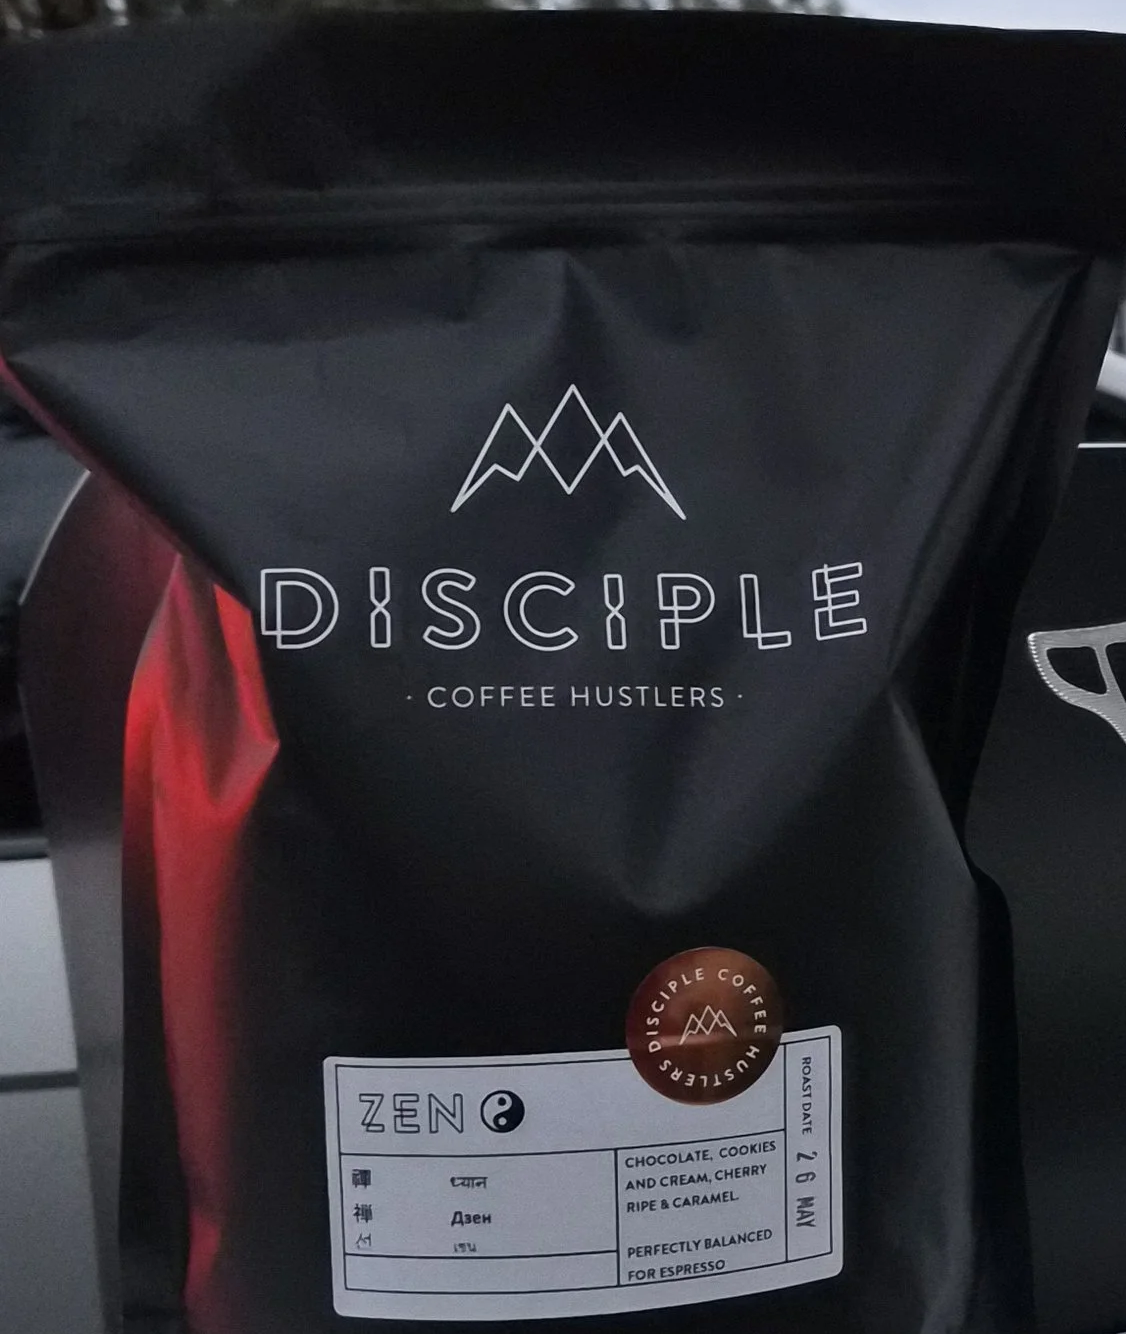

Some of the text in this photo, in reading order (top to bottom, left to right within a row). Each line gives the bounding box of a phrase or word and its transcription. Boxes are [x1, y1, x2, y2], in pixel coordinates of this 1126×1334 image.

[260, 561, 868, 652] DISCIPLE
[426, 685, 726, 710] COFFEE HUSTLERS
[645, 967, 767, 1088] DISCIPLE COFFEE HUSTLERS
[801, 1056, 813, 1136] ROAST DATE
[358, 1092, 465, 1135] ZEN
[624, 1140, 777, 1169] CHOCOLATE, COOKIES
[625, 1163, 768, 1191] AND CREAM, CHERRY
[450, 1210, 492, 1227] Дзен
[626, 1199, 657, 1213] RIPE
[660, 1198, 670, 1210] &
[796, 1196, 816, 1228] MAY
[627, 1228, 773, 1259] PERFECTLY BALANCED
[627, 1259, 726, 1282] FOR ESPRESSO
